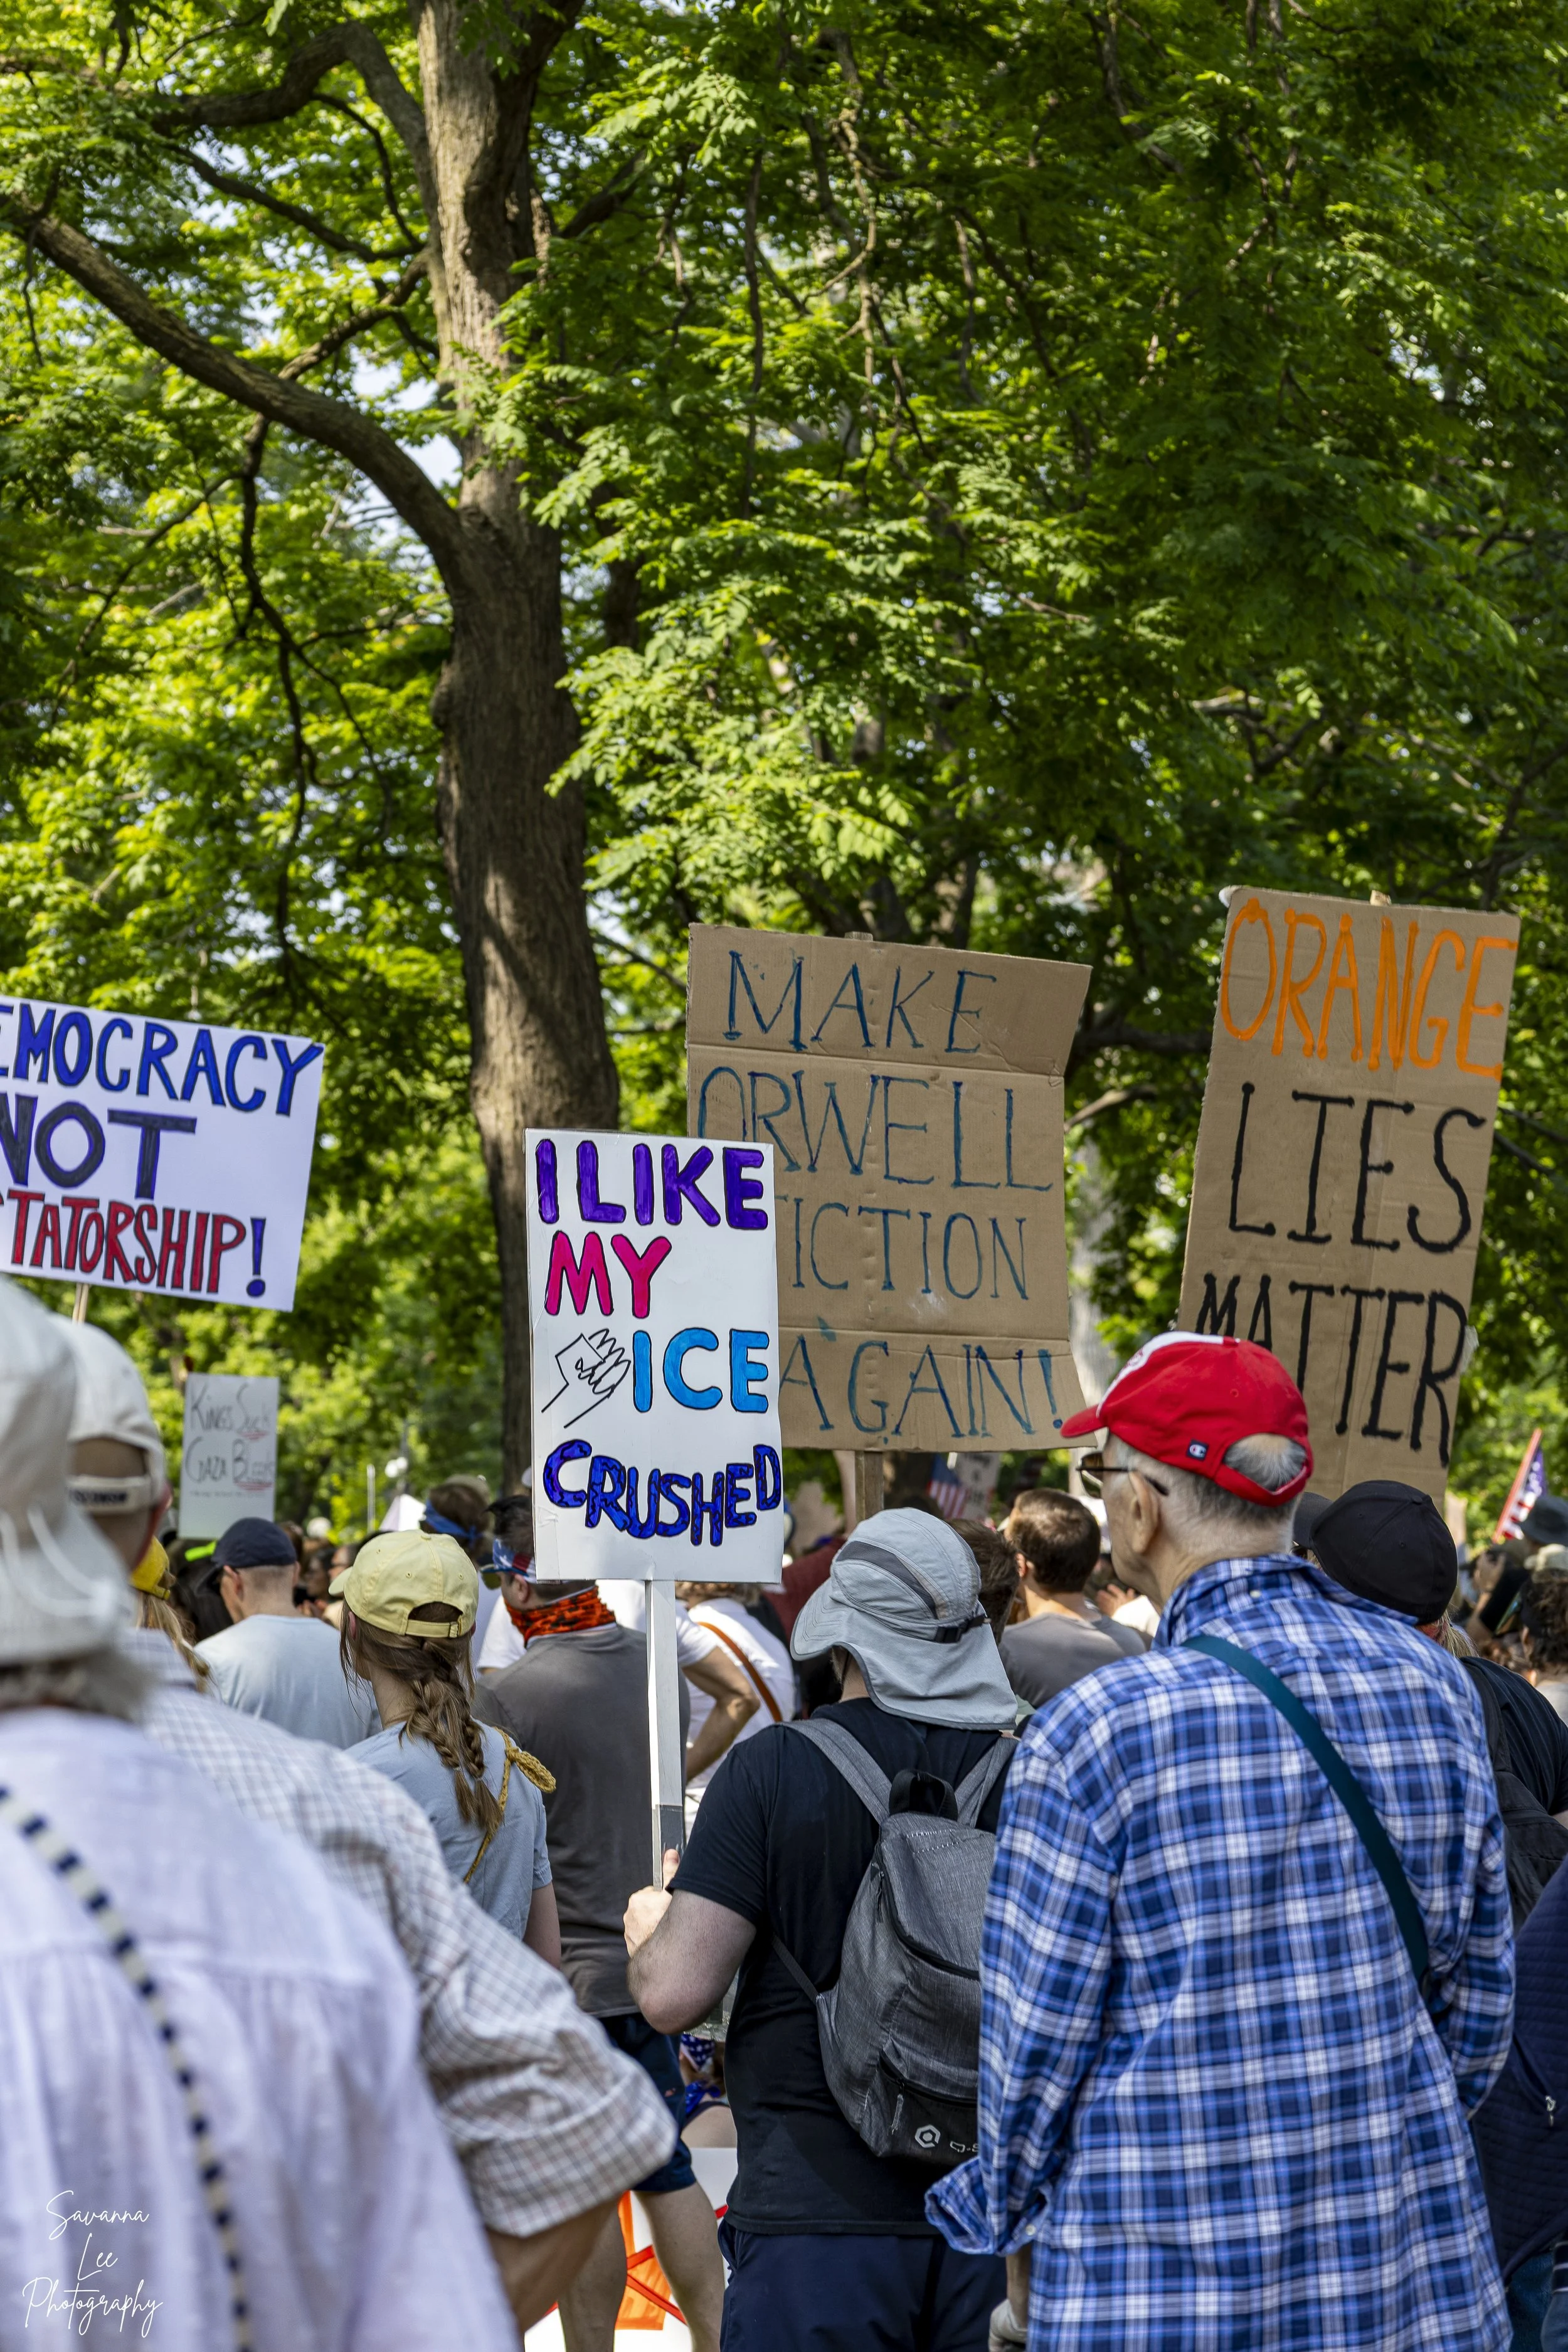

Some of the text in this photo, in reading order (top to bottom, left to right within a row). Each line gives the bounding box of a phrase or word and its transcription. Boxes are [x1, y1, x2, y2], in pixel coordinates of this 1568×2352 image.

[723, 950, 997, 1053] MAKE
[1220, 898, 1518, 1081] ORANGE
[697, 1066, 1054, 1192] ORWELL
[1228, 1082, 1486, 1253] LIES
[535, 1138, 769, 1230] I LIKE
[0, 1189, 267, 1297] TATORSHIP!
[544, 1230, 672, 1318] MY
[775, 1194, 1029, 1301] ICTION
[632, 1327, 770, 1413] ICE
[778, 1333, 1064, 1439] AGAIN!
[543, 1439, 781, 1547] CRUSHED
